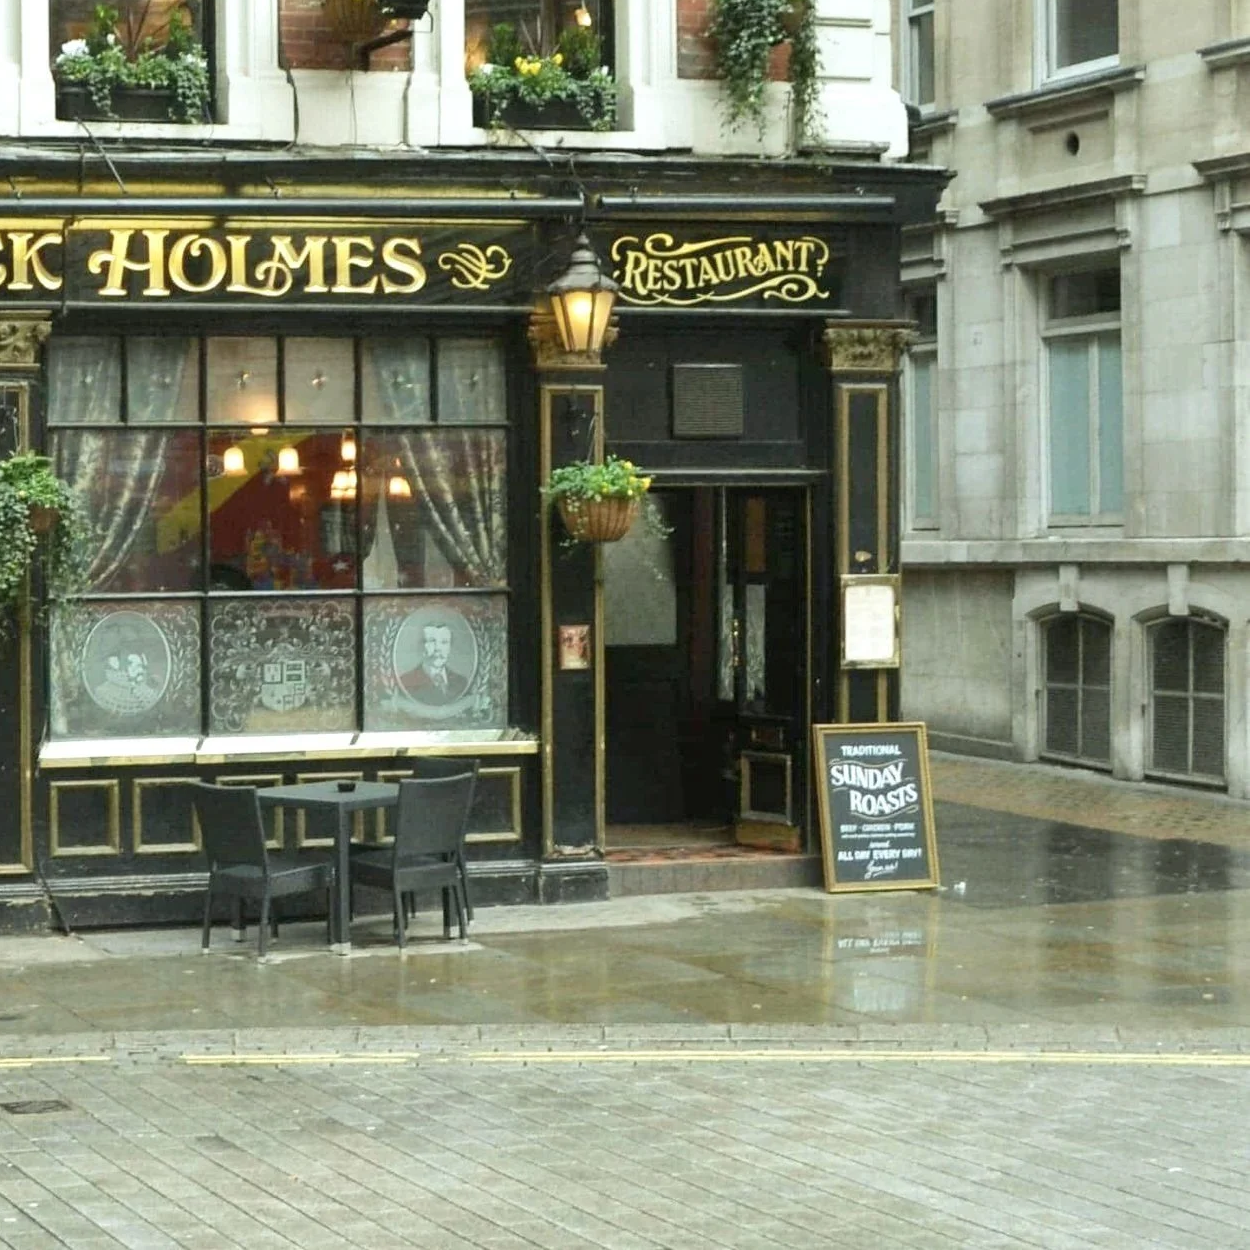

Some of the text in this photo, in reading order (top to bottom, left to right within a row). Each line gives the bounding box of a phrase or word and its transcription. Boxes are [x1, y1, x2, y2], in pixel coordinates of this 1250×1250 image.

[88, 228, 427, 296] HOLMES
[621, 240, 815, 296] RESTAURANT
[840, 744, 903, 756] TRADITIONAL
[830, 762, 904, 790] SUNDAY
[849, 783, 918, 816] ROASTS
[838, 851, 854, 861] ALL
